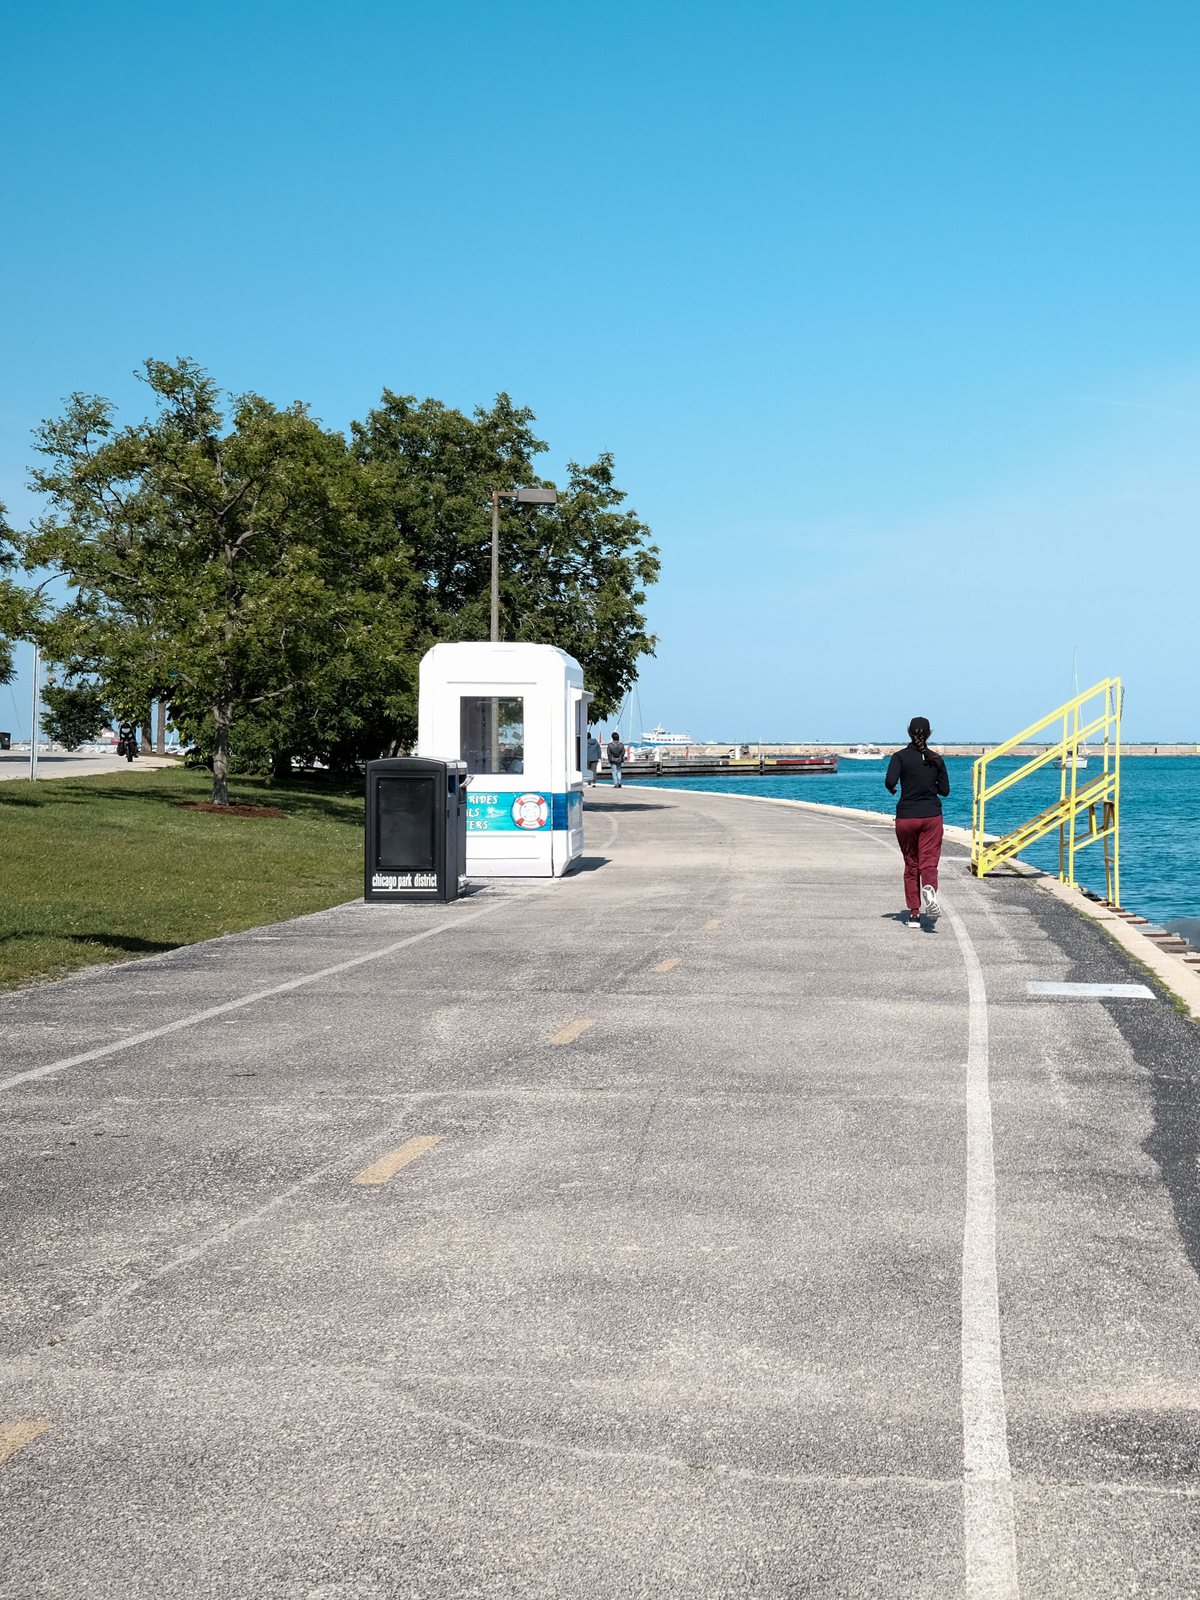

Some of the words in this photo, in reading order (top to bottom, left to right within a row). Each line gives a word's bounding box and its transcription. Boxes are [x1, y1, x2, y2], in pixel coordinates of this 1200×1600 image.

[469, 795, 498, 805] RIDES
[372, 873, 397, 889] chicago
[397, 873, 412, 889] park
[414, 873, 437, 887] district
